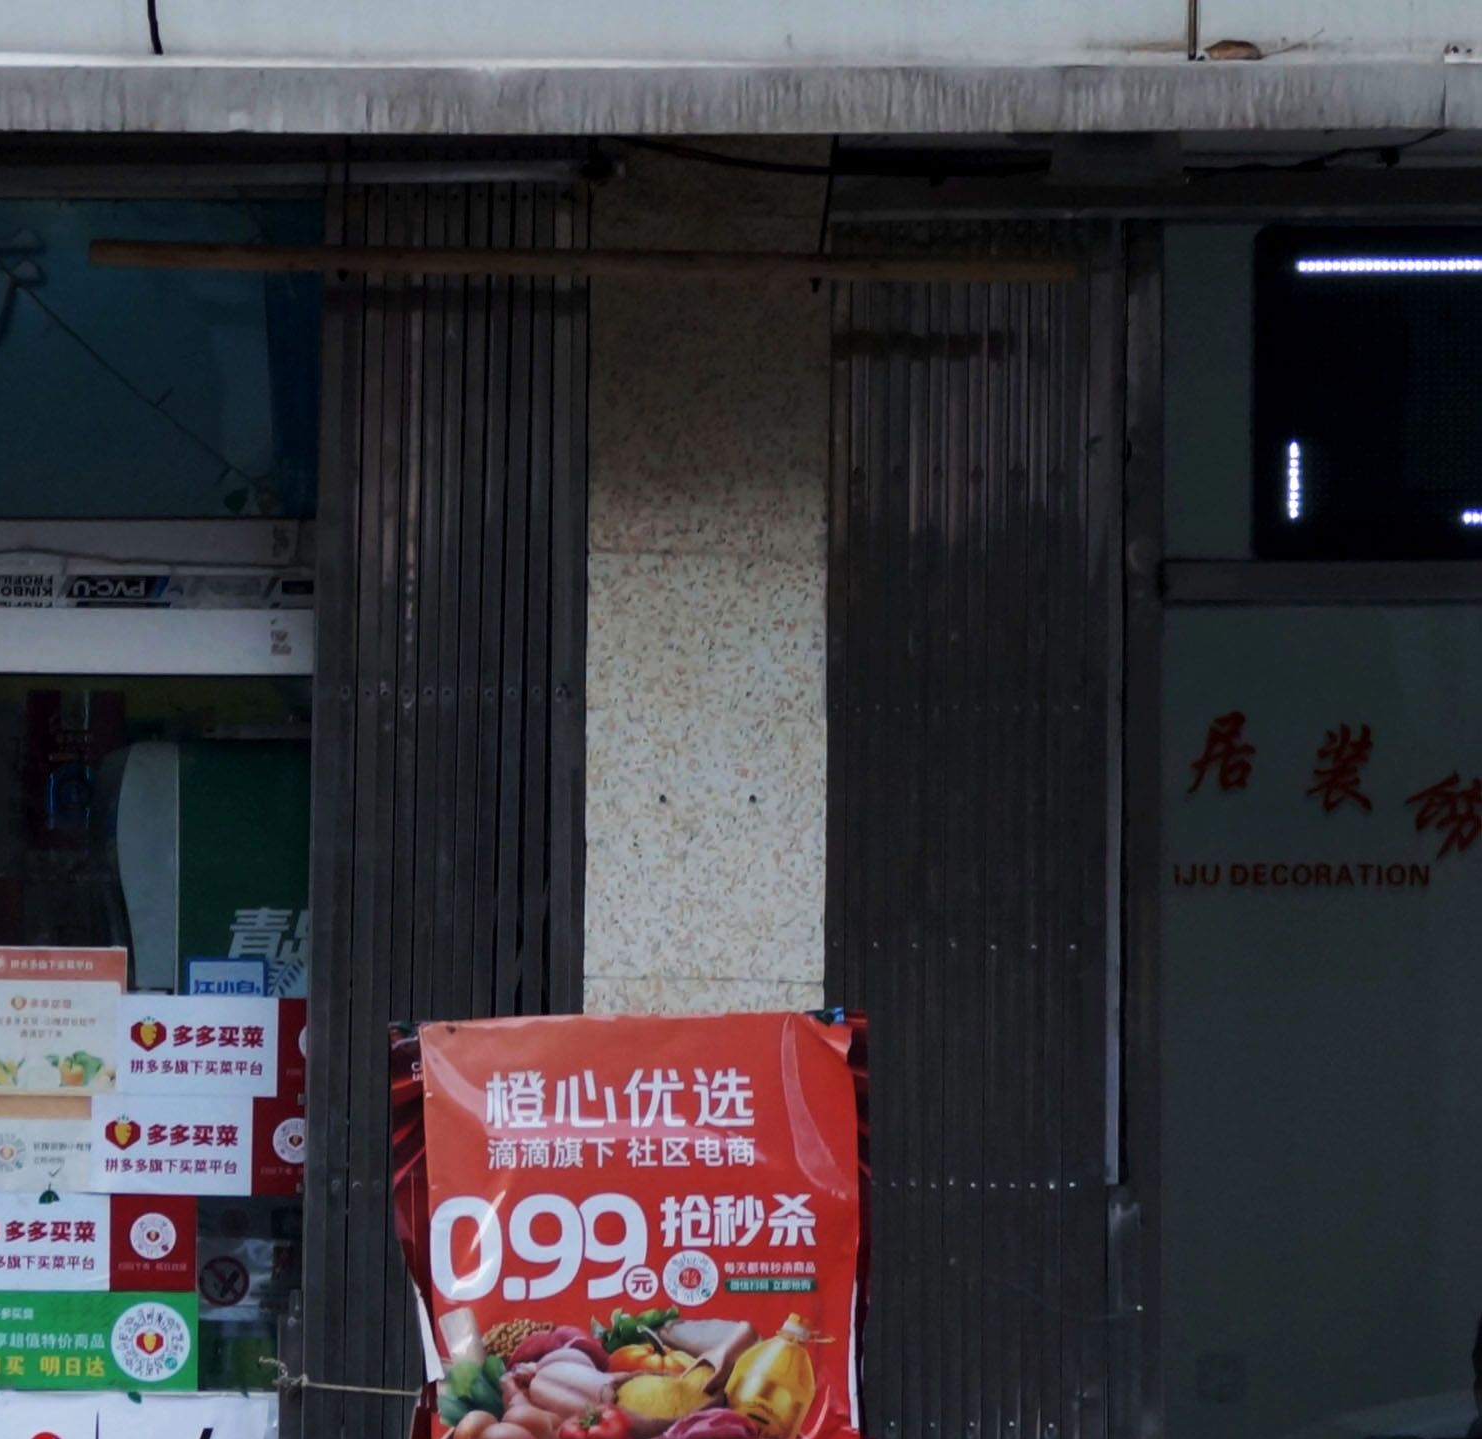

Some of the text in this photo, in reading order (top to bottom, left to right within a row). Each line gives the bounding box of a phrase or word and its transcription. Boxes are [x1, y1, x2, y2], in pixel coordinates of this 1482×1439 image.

[1230, 863, 1431, 888] DECORATION
[173, 1025, 264, 1048] 多多买菜
[130, 1059, 263, 1076] 拼多多旗下买菜平台
[485, 1067, 756, 1130] 橙心优选
[147, 1123, 239, 1147] 多多买菜
[487, 1135, 756, 1170] 滴滴旗下 社区电商
[104, 1157, 238, 1175] 拼多多旗下买菜平台
[5, 1221, 96, 1243] 多多买菜
[430, 1192, 817, 1301] 0.99 元 抢秒杀
[724, 1261, 817, 1274] 每天都有秒杀商品
[39, 1355, 106, 1378] 明日达
